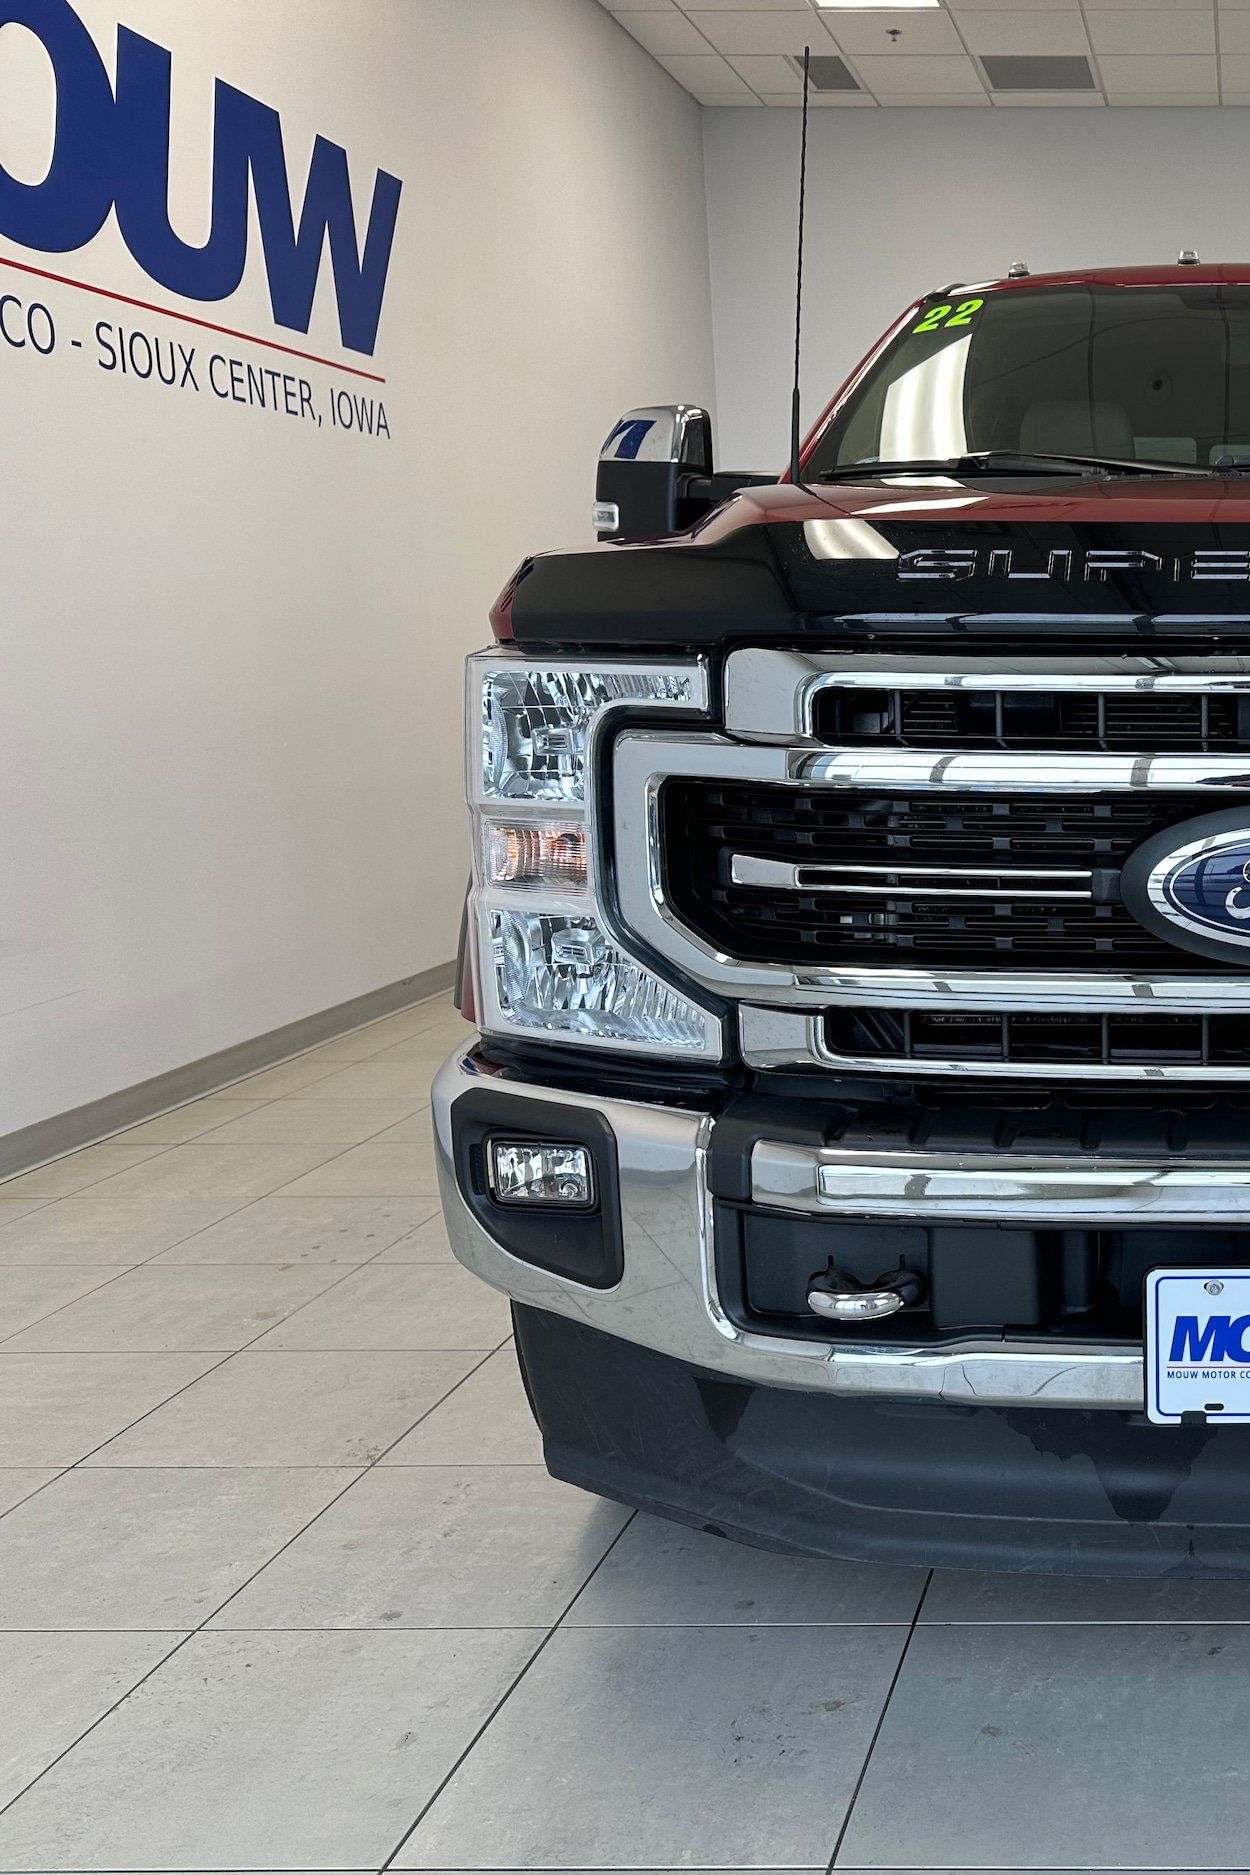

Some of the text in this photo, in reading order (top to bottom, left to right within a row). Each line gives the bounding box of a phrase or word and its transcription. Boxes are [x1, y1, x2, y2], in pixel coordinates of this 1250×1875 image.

[912, 299, 984, 334] 22
[0, 294, 56, 355] CO
[95, 321, 199, 391] SIOUX
[209, 354, 322, 428] CENTER,
[331, 388, 391, 439] IOWA
[1166, 1370, 1199, 1379] MOUW
[1202, 1370, 1236, 1379] MOTOR
